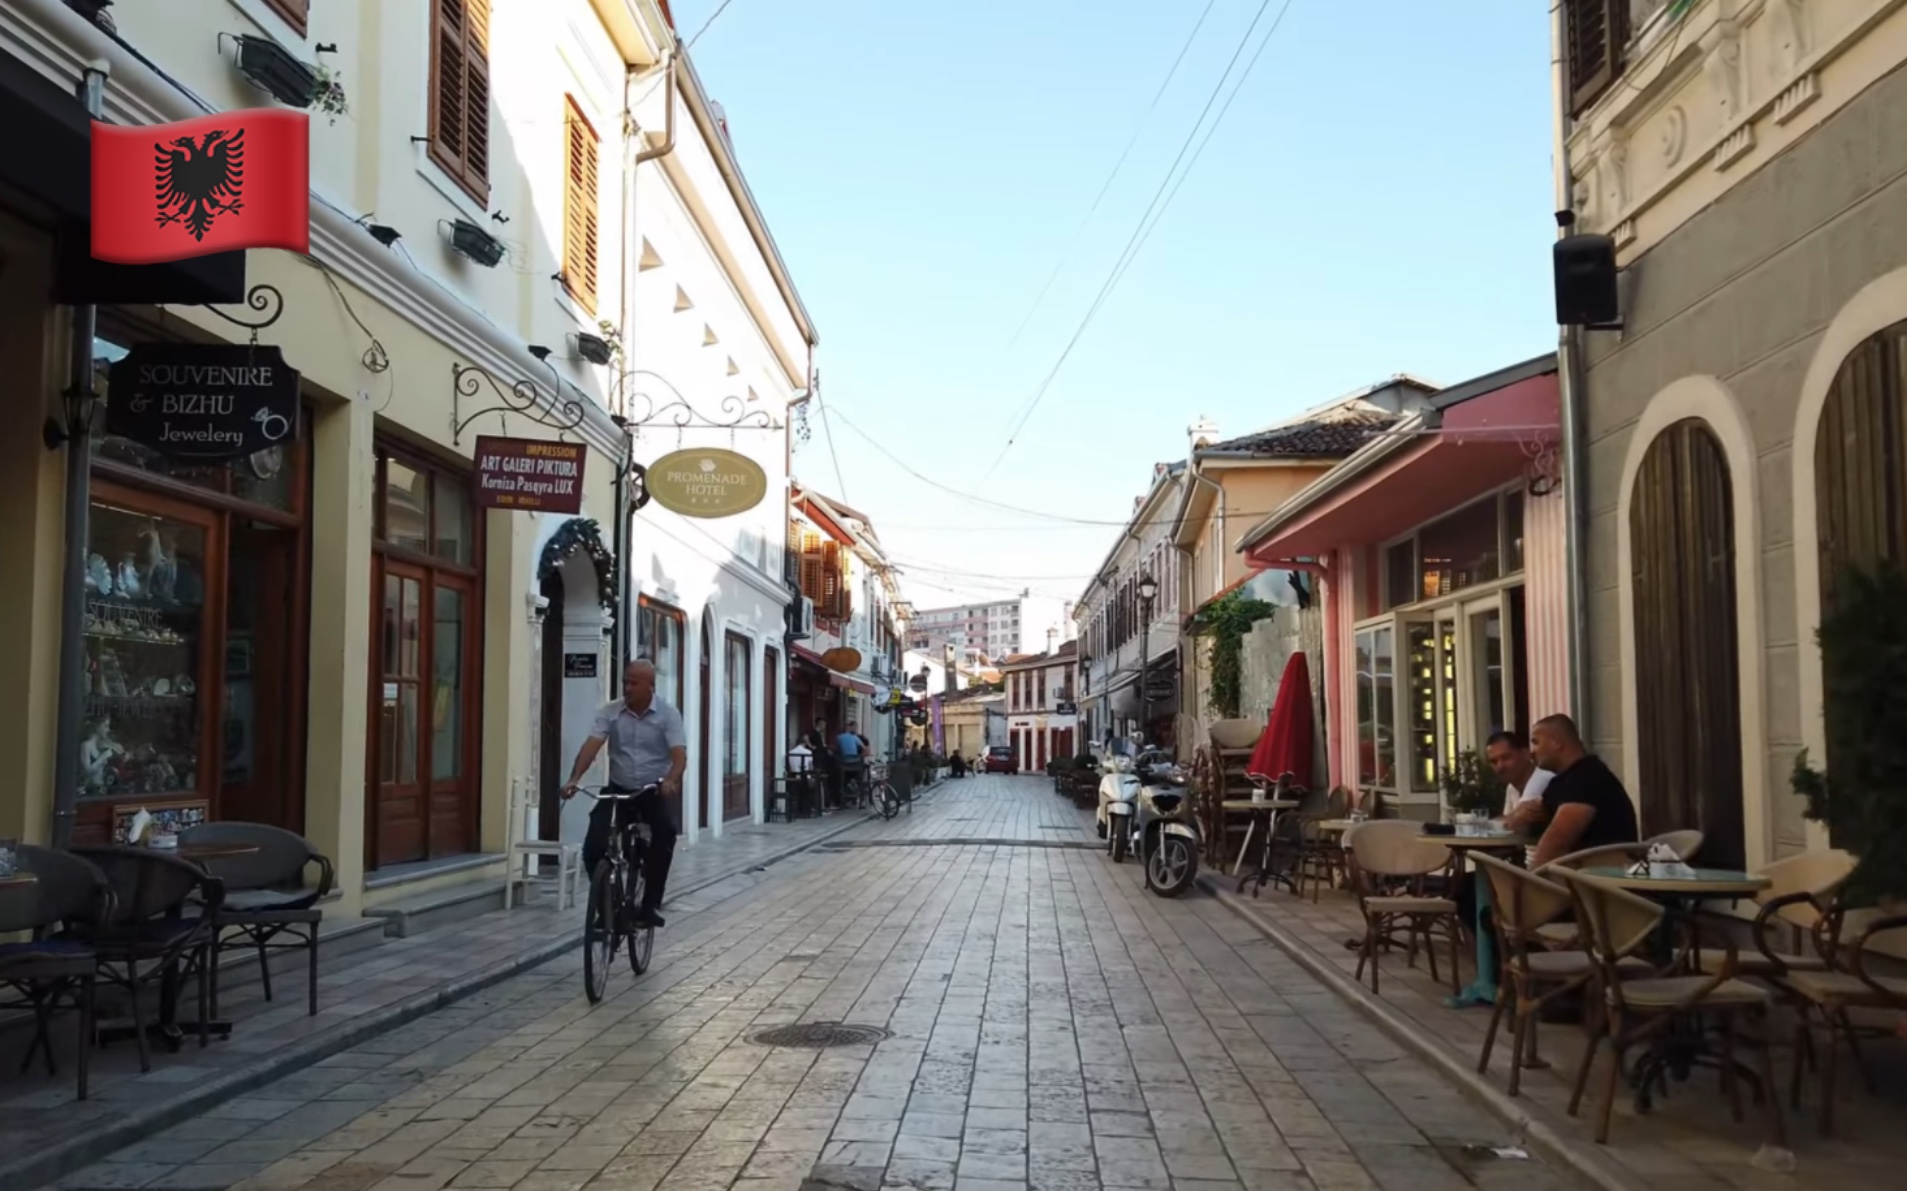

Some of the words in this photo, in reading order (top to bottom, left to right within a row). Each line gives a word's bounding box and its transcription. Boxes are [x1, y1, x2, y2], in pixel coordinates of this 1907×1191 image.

[139, 364, 274, 387] SOUVENIRE
[130, 393, 153, 413] &
[162, 394, 235, 415] BIZHU
[158, 422, 244, 447] Jewelery
[526, 445, 577, 458] IMPRESSION
[480, 455, 501, 471] ART
[502, 456, 535, 474] GALERI
[536, 459, 578, 477] PIKTURA
[481, 473, 515, 490] Korniza
[517, 475, 553, 495] Pasqyra
[554, 479, 575, 495] LUX
[667, 471, 749, 485] PROMENADE
[685, 484, 728, 496] HOTEL
